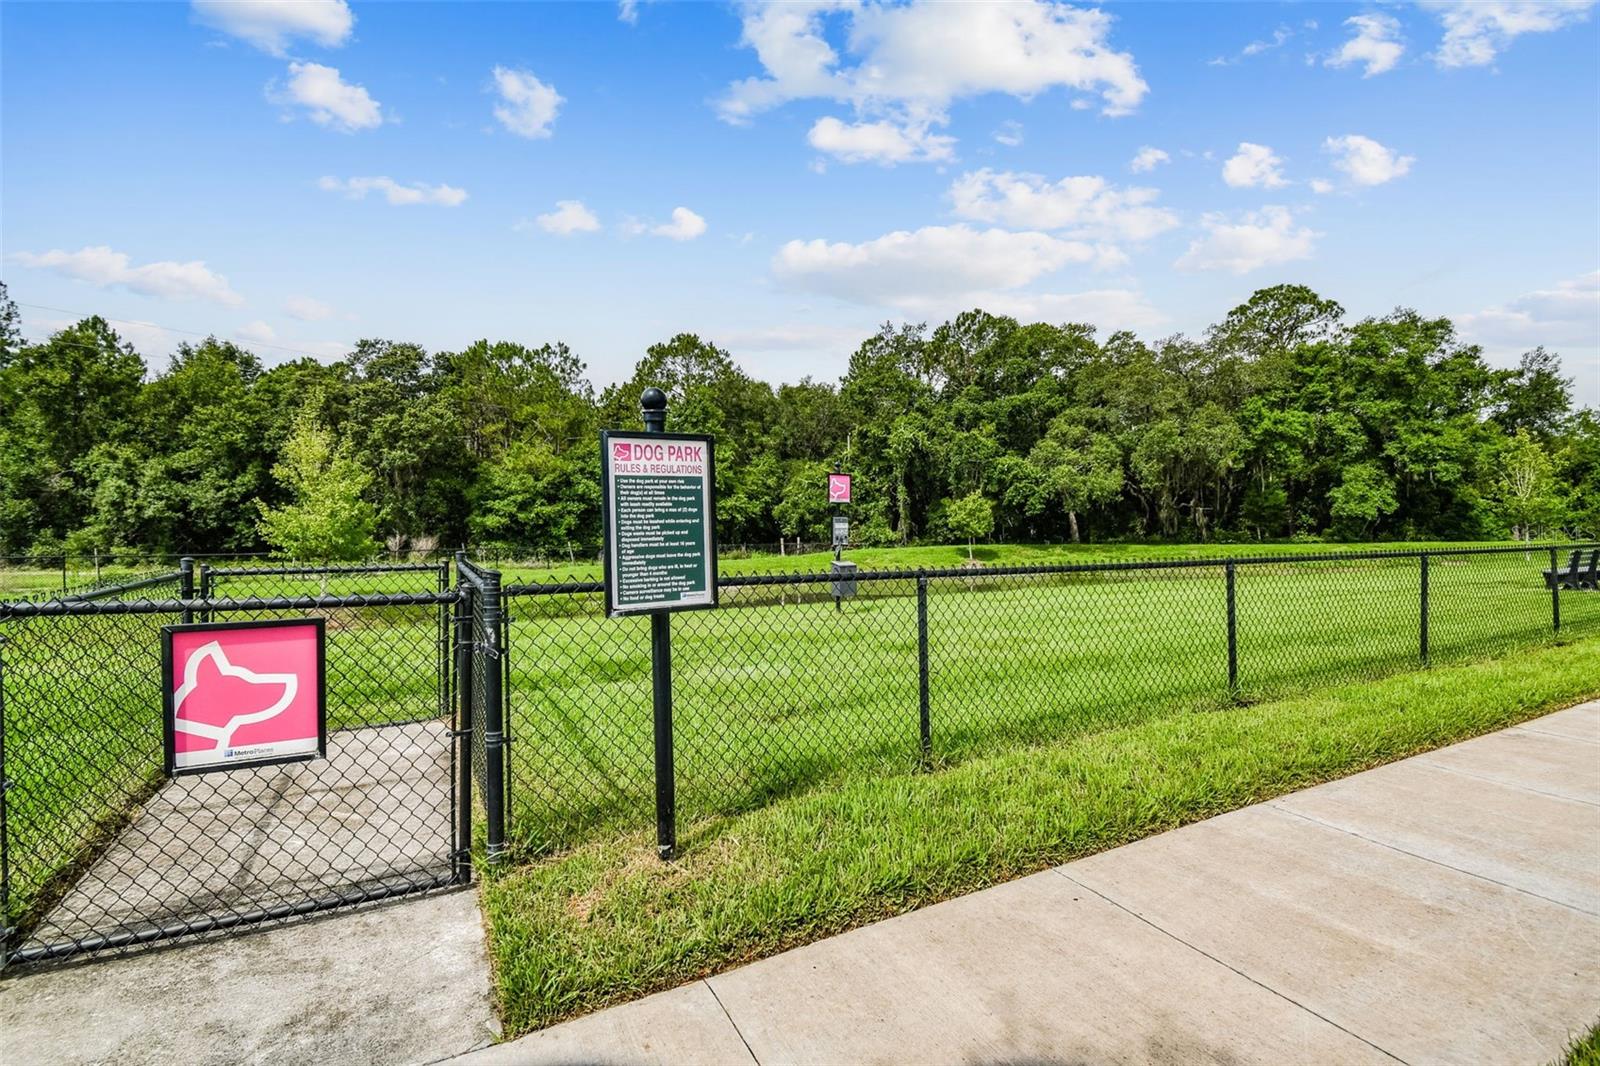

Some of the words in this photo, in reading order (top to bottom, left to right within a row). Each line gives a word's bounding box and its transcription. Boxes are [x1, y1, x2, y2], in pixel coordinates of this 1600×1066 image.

[634, 444, 663, 461] DOG
[668, 446, 702, 462] PARK
[615, 463, 640, 473] RULES
[643, 464, 648, 473] &
[650, 464, 702, 474] REGULATIONS
